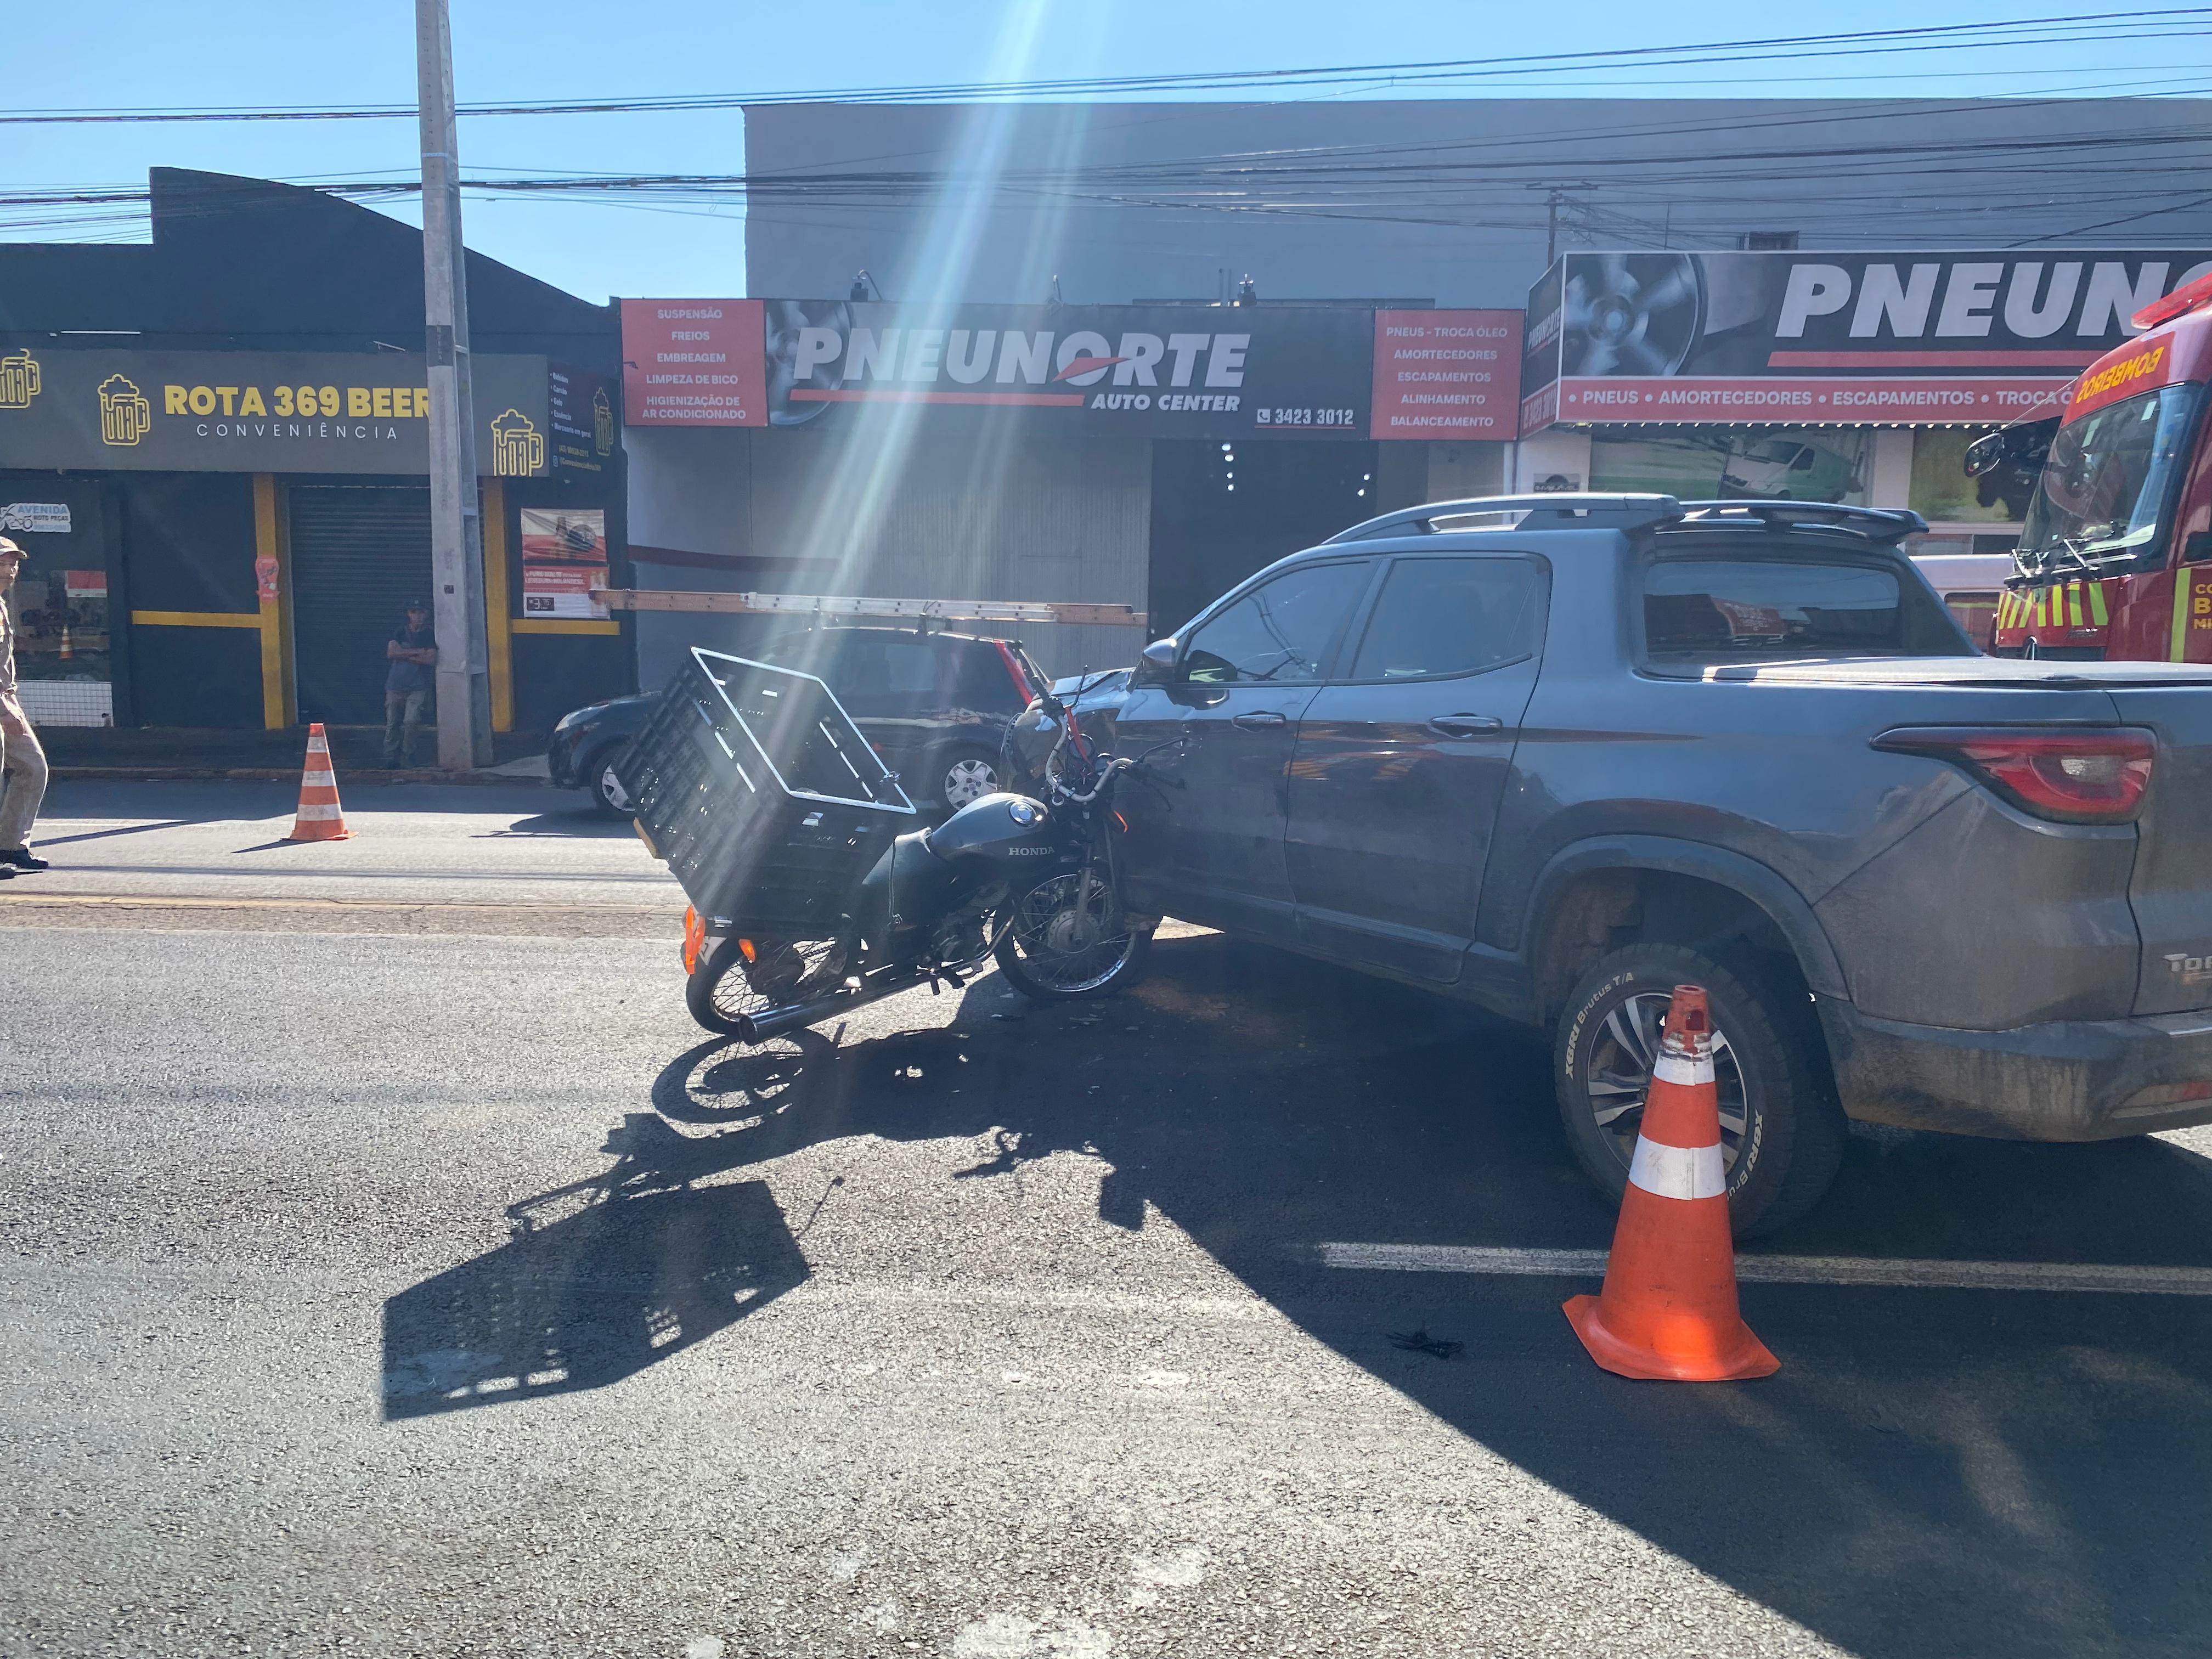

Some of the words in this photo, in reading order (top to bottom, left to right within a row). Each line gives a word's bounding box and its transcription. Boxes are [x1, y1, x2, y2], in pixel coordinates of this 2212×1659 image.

[657, 307, 723, 319] SUSPENSÃO
[671, 331, 710, 341] FREIOS
[1386, 327, 1425, 337] PNEUS
[1434, 328, 1475, 338] TROCA
[1476, 325, 1508, 338] ÓLEO
[657, 353, 726, 363] EMBREAGEM
[793, 327, 1251, 387] PNEUNORTE
[1394, 349, 1498, 360] AMORTECEDORES
[646, 375, 693, 385] LIMPEZA
[695, 375, 710, 385] DE
[712, 375, 738, 385] BICO
[1397, 372, 1492, 383] ESCAPAMENTOS
[165, 385, 268, 416] ROTA
[274, 386, 340, 417] 369
[347, 387, 429, 417] BEER
[646, 394, 724, 408] HIGIENIZAÇÃO
[725, 397, 740, 407] DE
[1091, 394, 1151, 410] AUTO
[1158, 394, 1240, 411] CENTER
[1401, 394, 1486, 405] ALINHAMENTO
[1583, 391, 1639, 404] PNEUS
[1658, 390, 1812, 405] AMORTECEDORES
[1833, 390, 1974, 405] ESCAPAMENTOS
[1996, 390, 2057, 404] TROCA
[642, 409, 657, 419] AR
[659, 409, 747, 419] CONDICIONADO
[1274, 408, 1312, 425] 3423
[1317, 408, 1353, 425] 3012
[1391, 416, 1494, 427] BALANCEAMENTO
[196, 422, 397, 439] CONVENIÊNCIA
[18, 505, 68, 514] AVENIDA
[1008, 846, 1056, 856] HONDA
[1565, 1023, 1580, 1081] XBRI
[1577, 983, 1612, 1025] Brutus
[1612, 972, 1634, 986] T/A
[1746, 1108, 1763, 1172] XBRI
[1727, 1169, 1748, 1202] Bru
